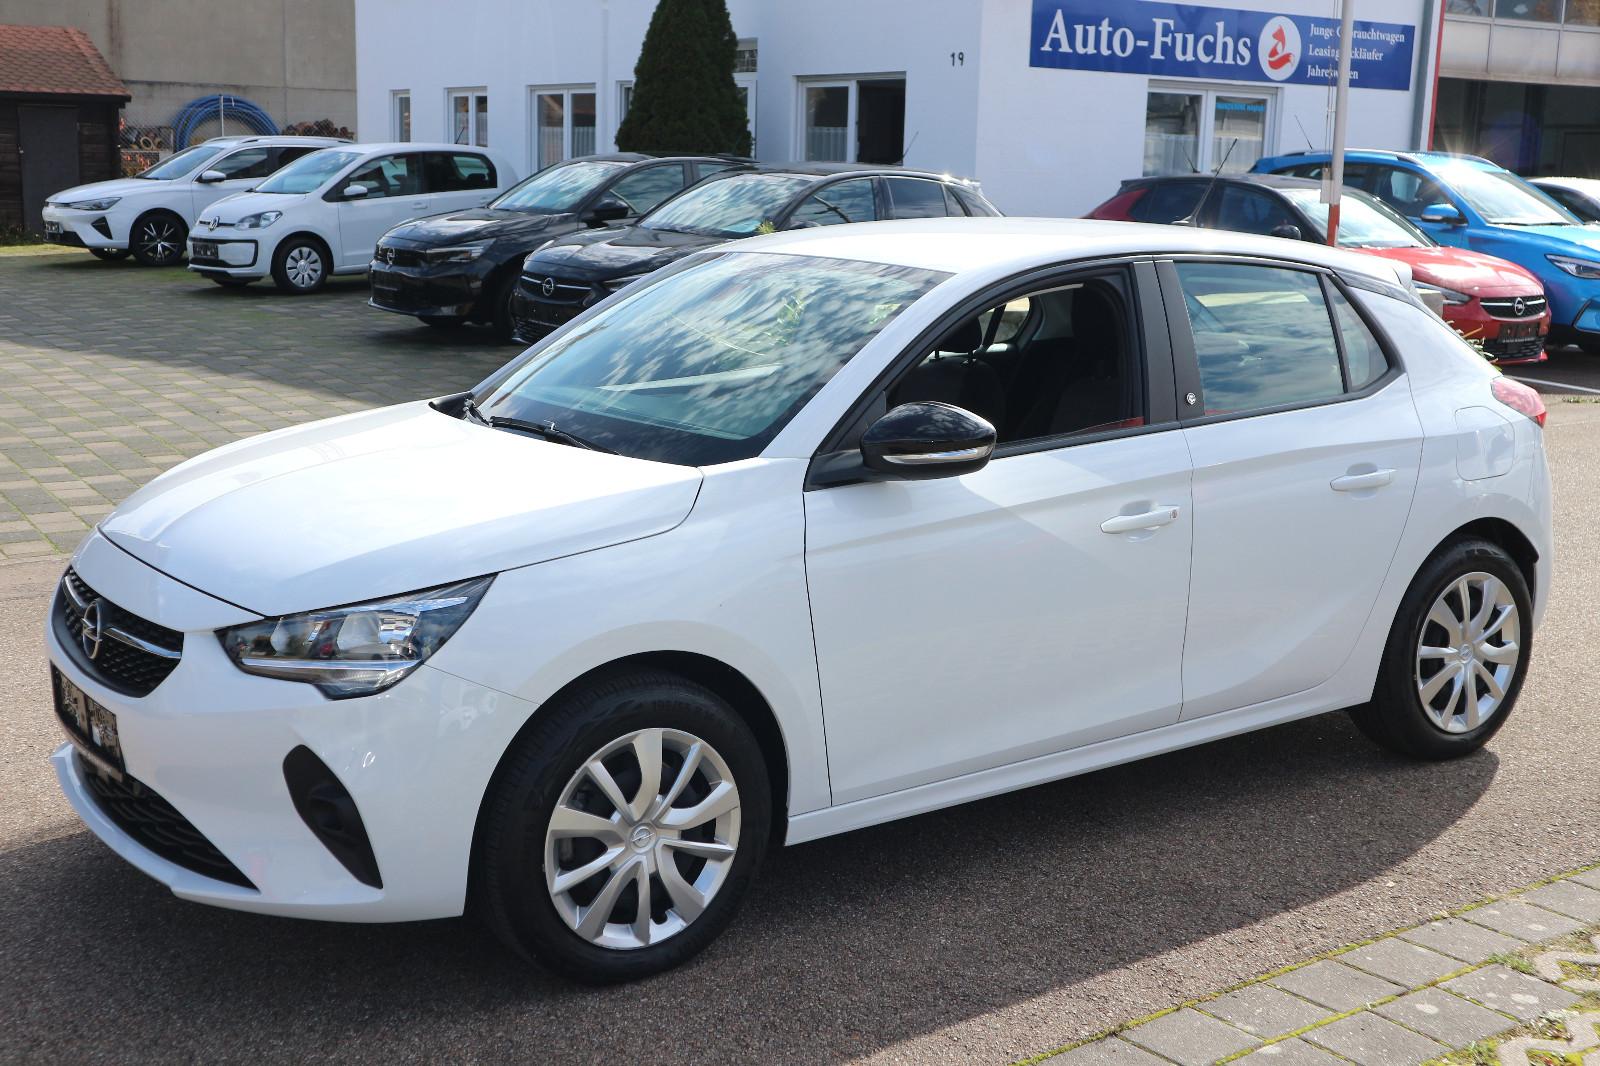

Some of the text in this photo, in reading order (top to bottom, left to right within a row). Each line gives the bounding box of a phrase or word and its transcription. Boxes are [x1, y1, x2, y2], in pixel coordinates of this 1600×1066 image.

[1040, 9, 1251, 66] Auto-Fuchs
[1310, 23, 1405, 45] Junge Grauchtwagen
[950, 51, 965, 67] 19
[1309, 44, 1384, 61] Leasingckläufer
